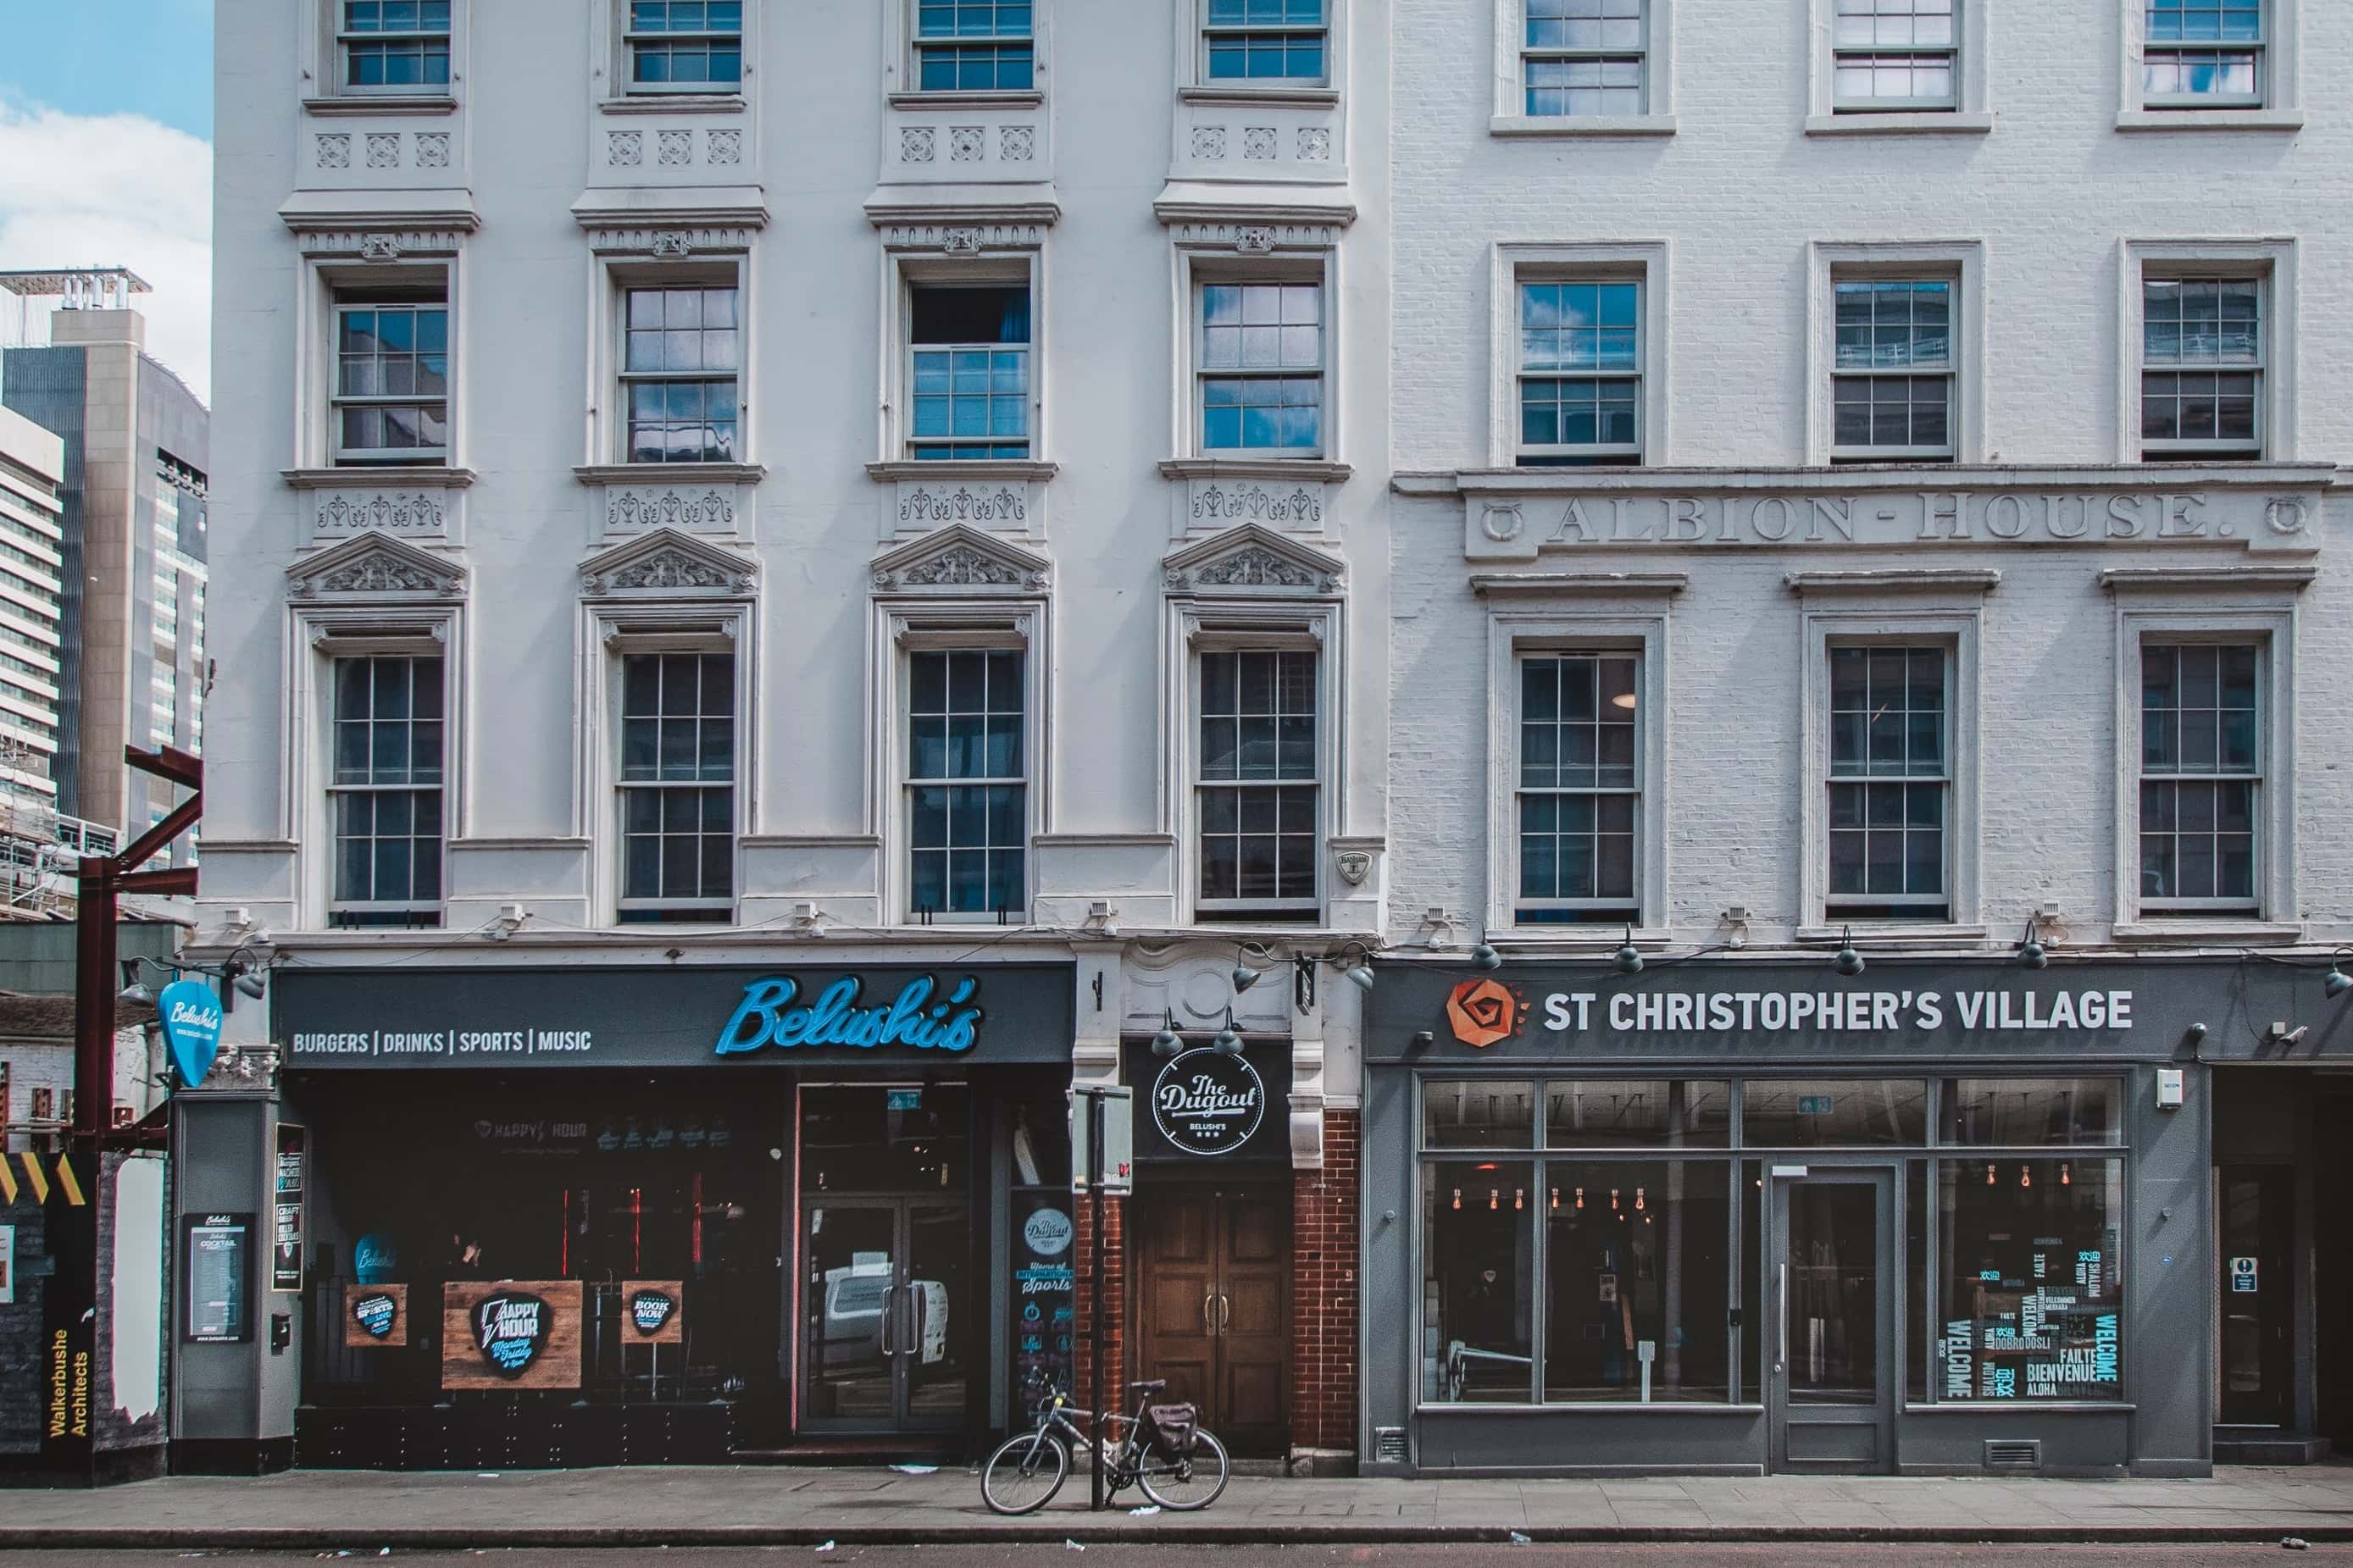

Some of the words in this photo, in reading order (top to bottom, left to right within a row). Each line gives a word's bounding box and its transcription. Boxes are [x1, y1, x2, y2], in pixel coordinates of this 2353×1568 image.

[1546, 495, 1858, 542] ALBION
[1917, 491, 2234, 540] HOUSE.
[170, 1002, 218, 1030] Belushi's
[715, 974, 981, 1055] Belushi's
[1543, 992, 1596, 1031] ST
[1608, 991, 1942, 1031] CHRISTOPHER'S
[1955, 990, 2133, 1030] VILLAGE
[293, 1033, 368, 1053] BURGERS
[384, 1033, 443, 1053] DRINKS
[459, 1031, 523, 1052] SPORTS
[538, 1030, 591, 1051] MUSIC
[1192, 1075, 1227, 1094] The
[1159, 1084, 1256, 1117] Dugout
[1023, 1277, 1072, 1294] Sports
[2076, 1263, 2086, 1284] ALOHA
[2088, 1263, 2101, 1298] SHALOM
[500, 1302, 540, 1318] HAPPY
[634, 1300, 669, 1311] BOOK
[635, 1310, 665, 1319] NOW
[2022, 1294, 2037, 1338] WELKOM
[498, 1318, 539, 1338] HOUR
[1947, 1320, 1972, 1398] WELCOME
[2060, 1349, 2095, 1363] FAILTE
[2095, 1314, 2117, 1382] WELCOME
[49, 1328, 68, 1438] Walkerbushe
[2027, 1364, 2096, 1382] BIENVENUE
[70, 1351, 88, 1437] Architects
[2027, 1382, 2057, 1397] ALOHA
